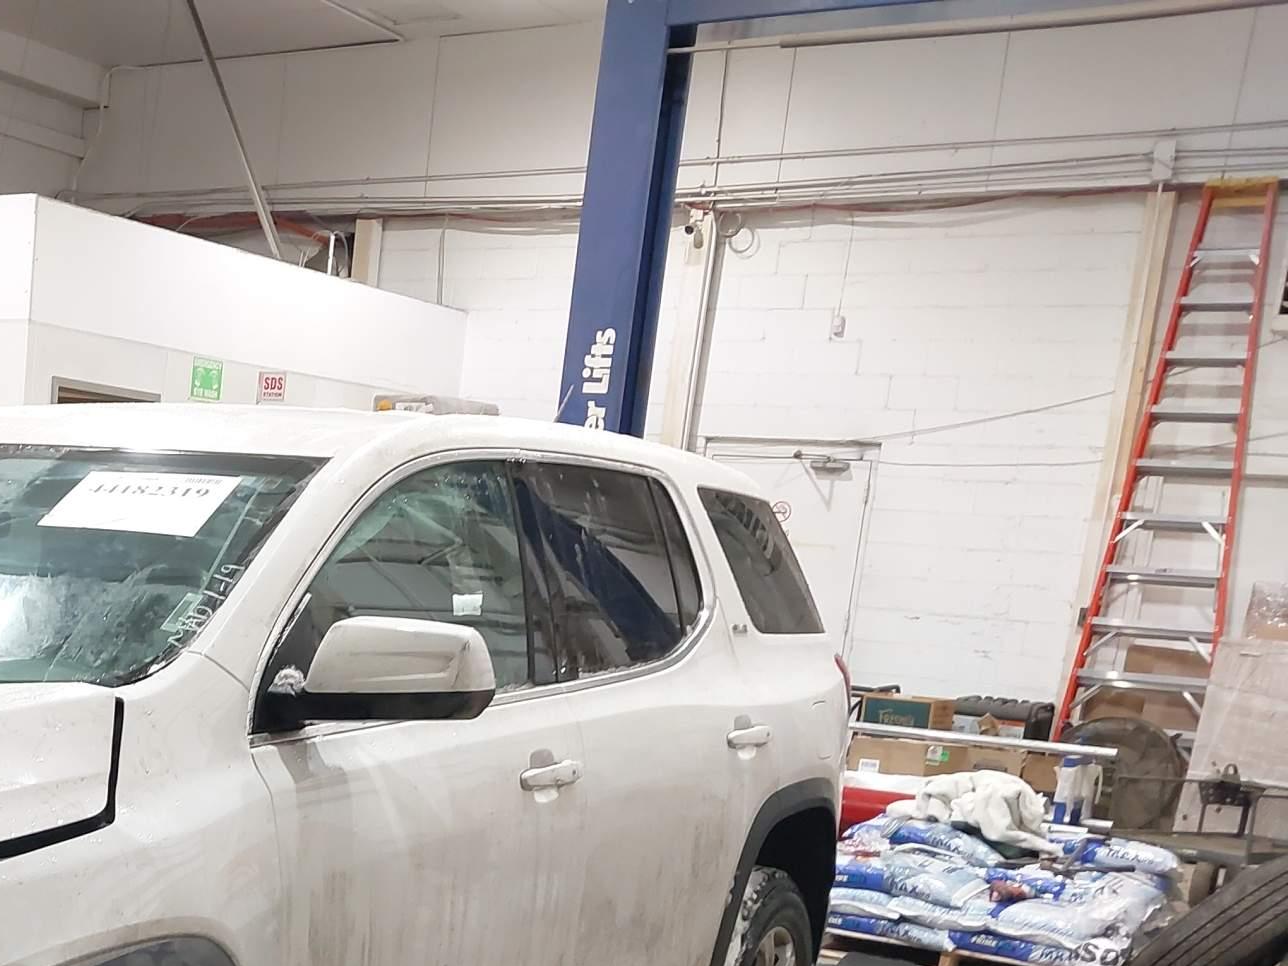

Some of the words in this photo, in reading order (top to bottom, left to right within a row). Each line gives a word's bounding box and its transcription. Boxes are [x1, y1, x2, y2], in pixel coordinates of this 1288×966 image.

[581, 327, 616, 394] Lifts
[264, 376, 283, 390] SDS
[203, 563, 246, 600] 1-19
